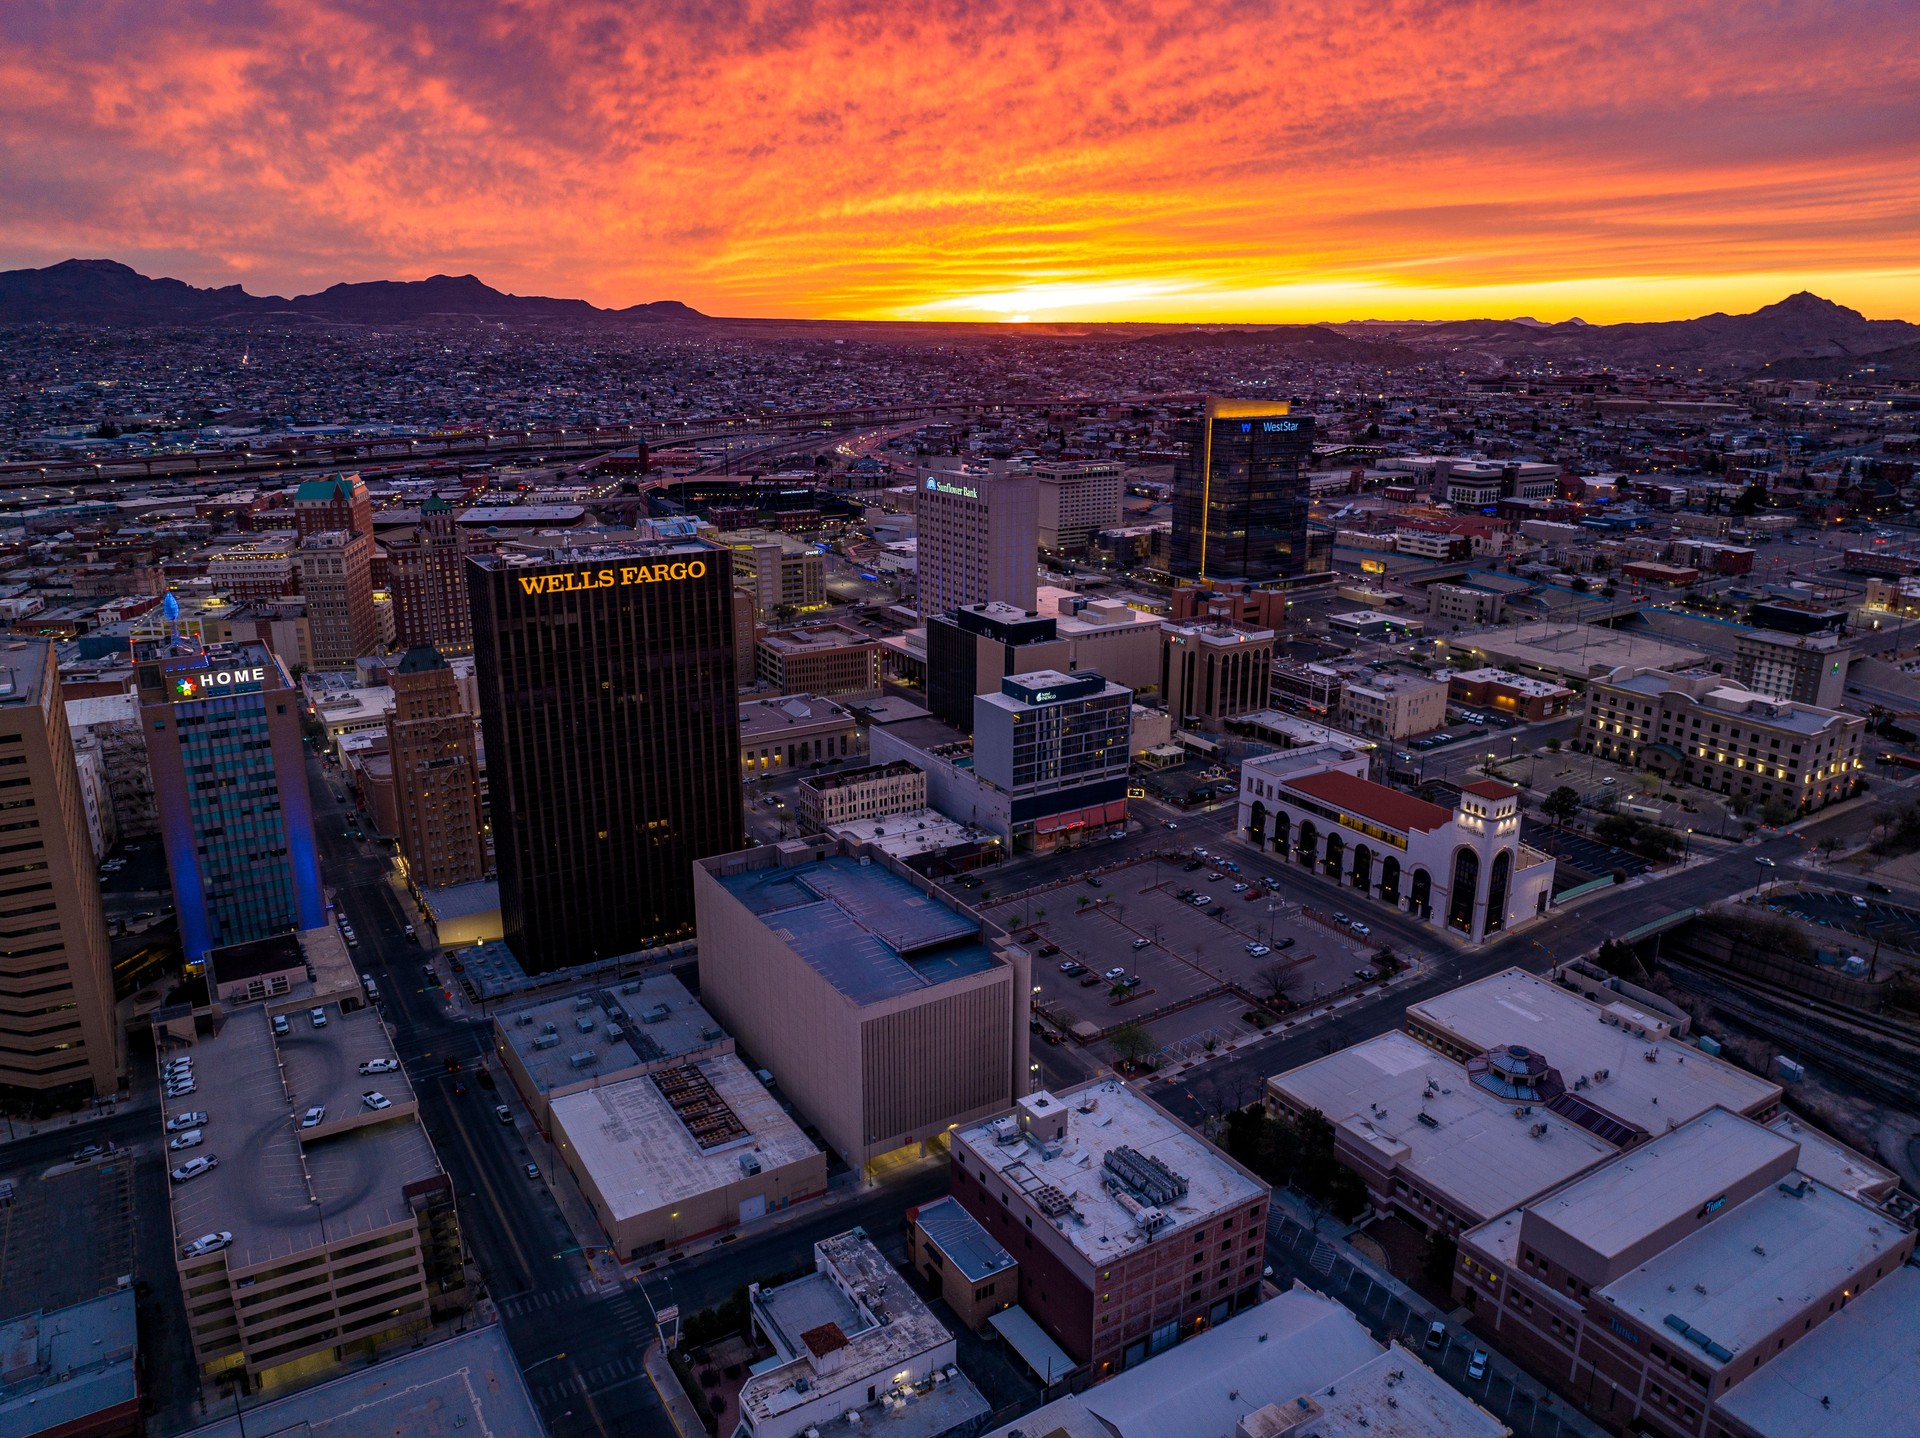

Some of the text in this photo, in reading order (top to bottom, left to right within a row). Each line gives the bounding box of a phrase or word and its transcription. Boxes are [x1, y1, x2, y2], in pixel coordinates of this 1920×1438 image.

[1263, 421, 1299, 432] WestStar
[937, 481, 978, 499] Sunflower Bank
[427, 509, 451, 517] PLAZA
[518, 561, 706, 595] WELLS FARGO
[200, 668, 265, 687] HOME
[1610, 1314, 1639, 1344] Times
